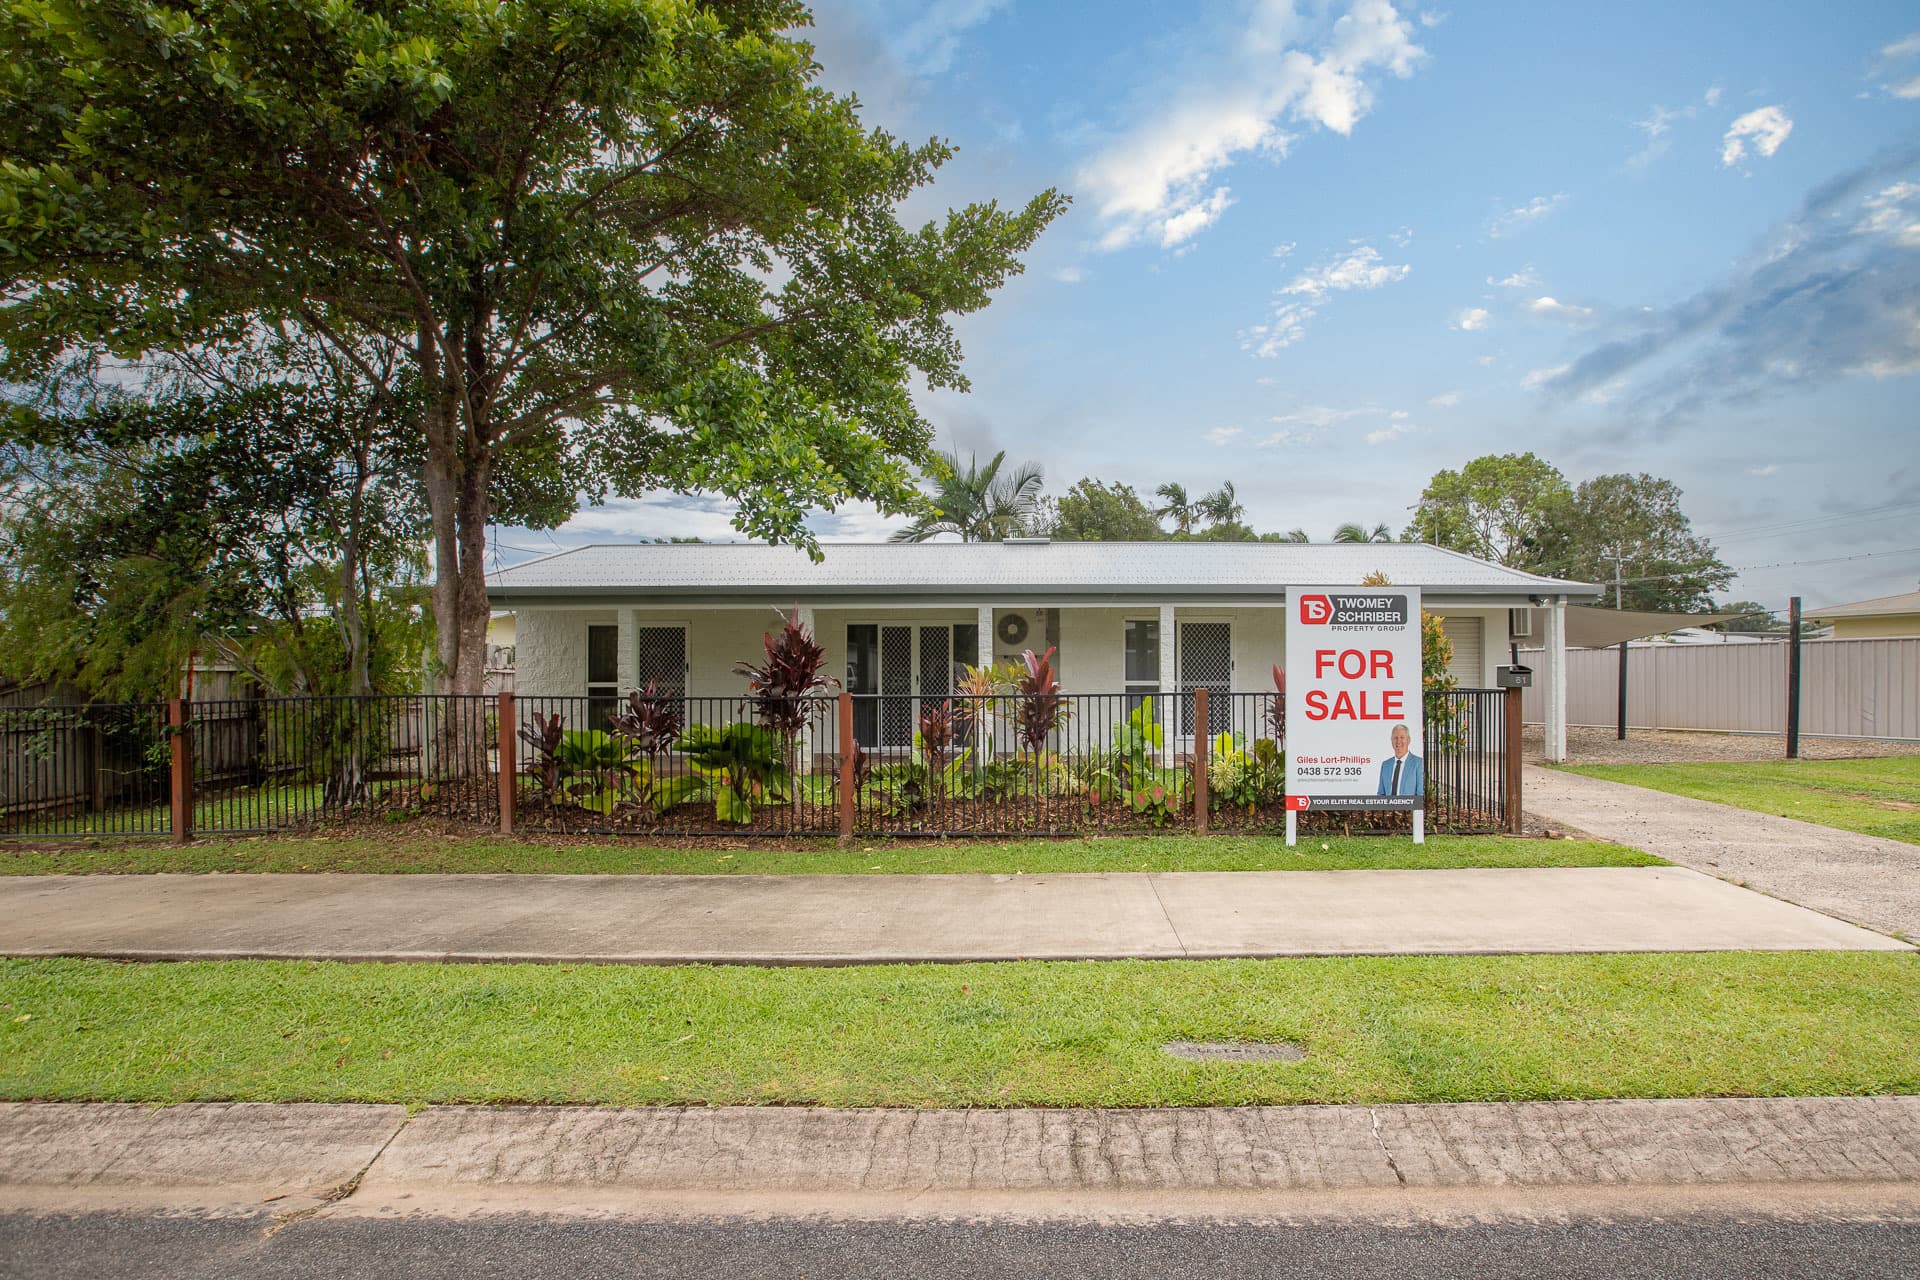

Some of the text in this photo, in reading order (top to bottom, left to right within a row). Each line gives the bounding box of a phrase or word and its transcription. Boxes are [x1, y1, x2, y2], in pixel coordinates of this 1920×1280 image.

[1337, 598, 1393, 609] TWOMEY
[1337, 611, 1401, 622] SCHRIBER
[1315, 649, 1394, 680] FOR
[1305, 690, 1405, 720] SALE
[1296, 756, 1371, 765] Giles Lort-Phillips
[1297, 767, 1362, 776] 0438 572 936
